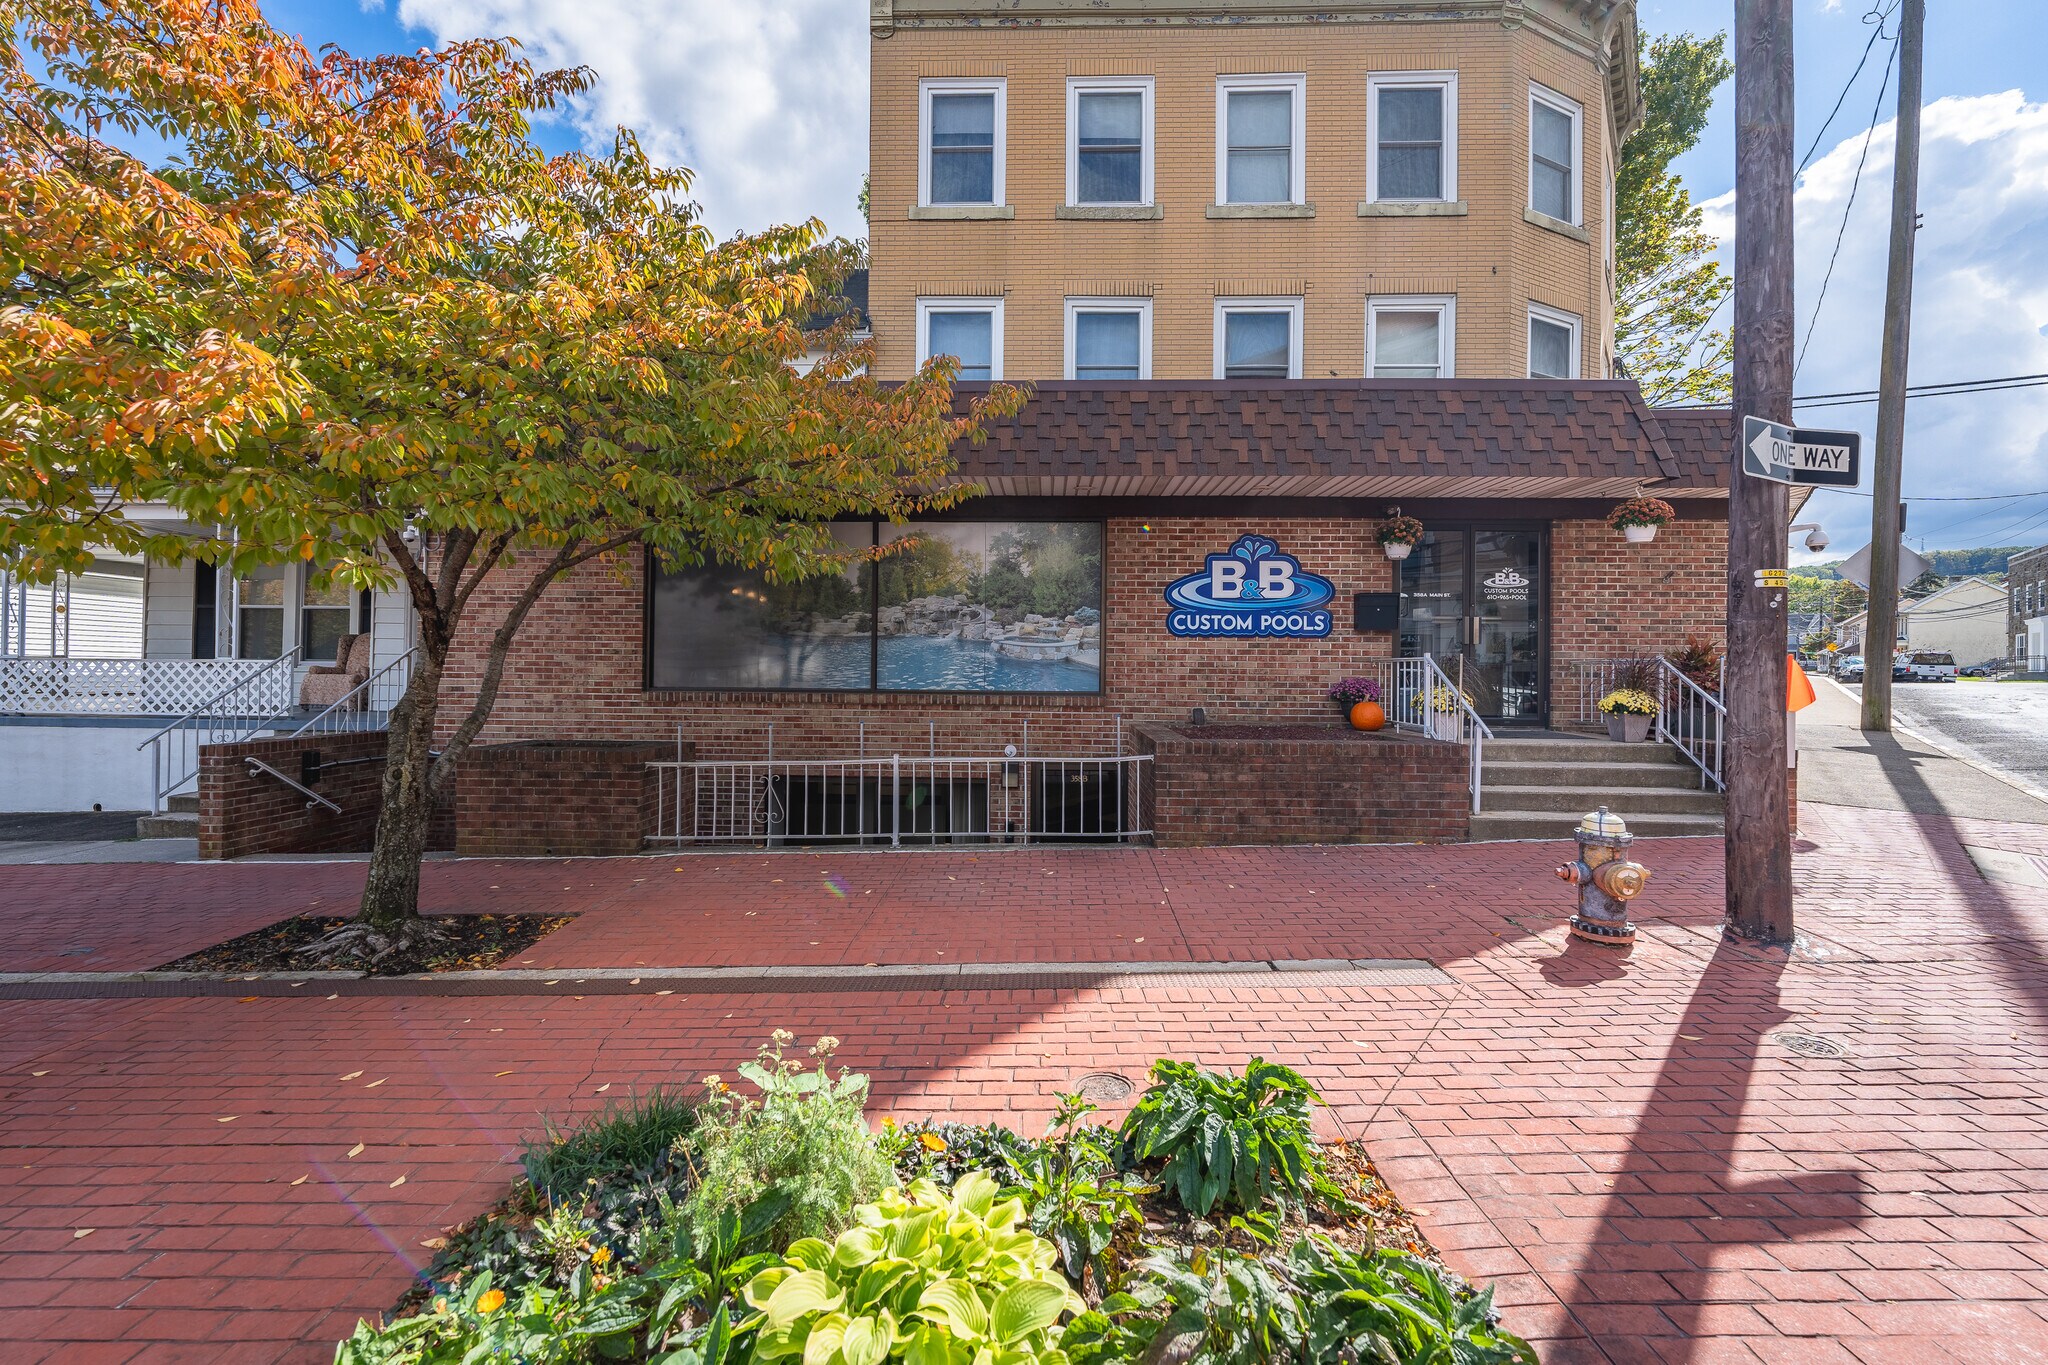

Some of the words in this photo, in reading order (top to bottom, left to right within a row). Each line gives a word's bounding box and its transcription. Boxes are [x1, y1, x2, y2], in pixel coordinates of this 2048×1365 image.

[1772, 441, 1796, 466] ONE
[1803, 446, 1844, 469] WAY
[1212, 560, 1295, 599] B&B
[1494, 572, 1520, 585] B&B
[1173, 614, 1253, 631] CUSTOM
[1260, 614, 1325, 631] POOLS
